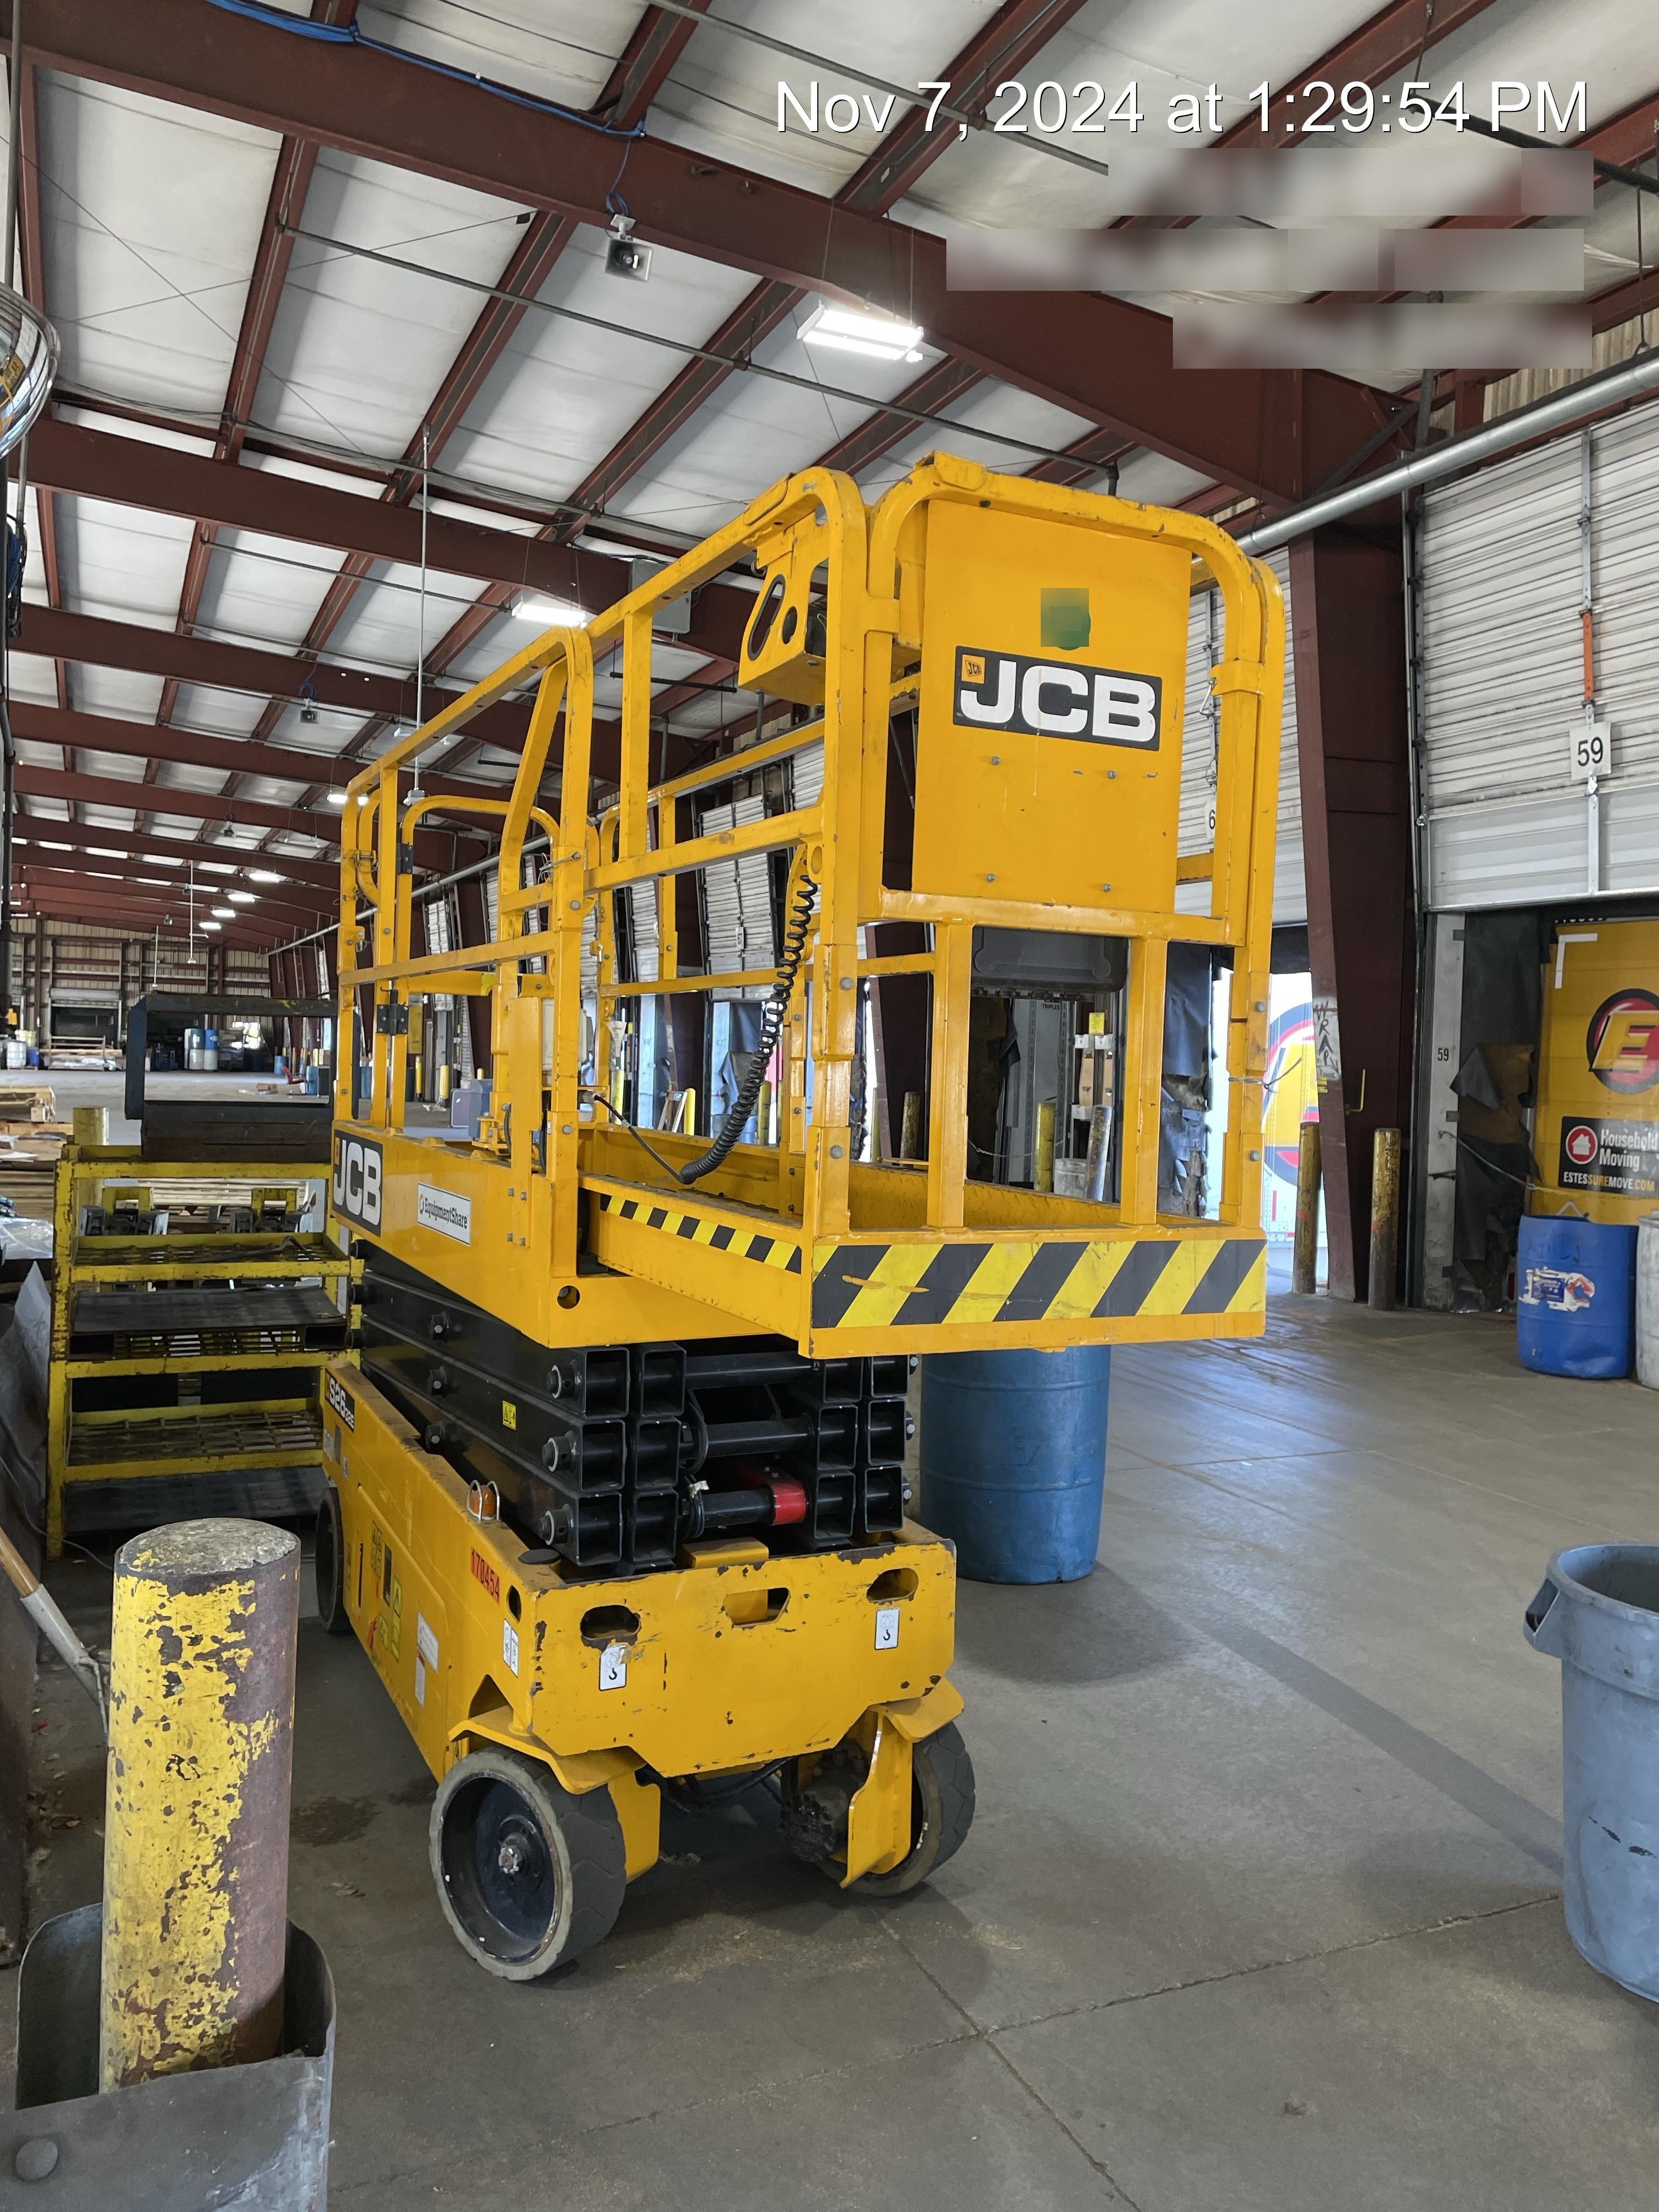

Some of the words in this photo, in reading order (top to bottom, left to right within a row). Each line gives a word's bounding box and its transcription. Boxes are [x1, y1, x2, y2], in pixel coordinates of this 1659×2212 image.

[968, 662, 981, 675] JCB
[960, 659, 1156, 742] JCB
[1578, 736, 1603, 766] 59
[1209, 809, 1215, 830] 6
[1437, 1048, 1449, 1062] 59
[1600, 1128, 1658, 1152] Household
[1599, 1148, 1640, 1172] Moving
[334, 1139, 381, 1226] JCB
[425, 1197, 468, 1229] EquipmentShare
[471, 1548, 500, 1598] 170454
